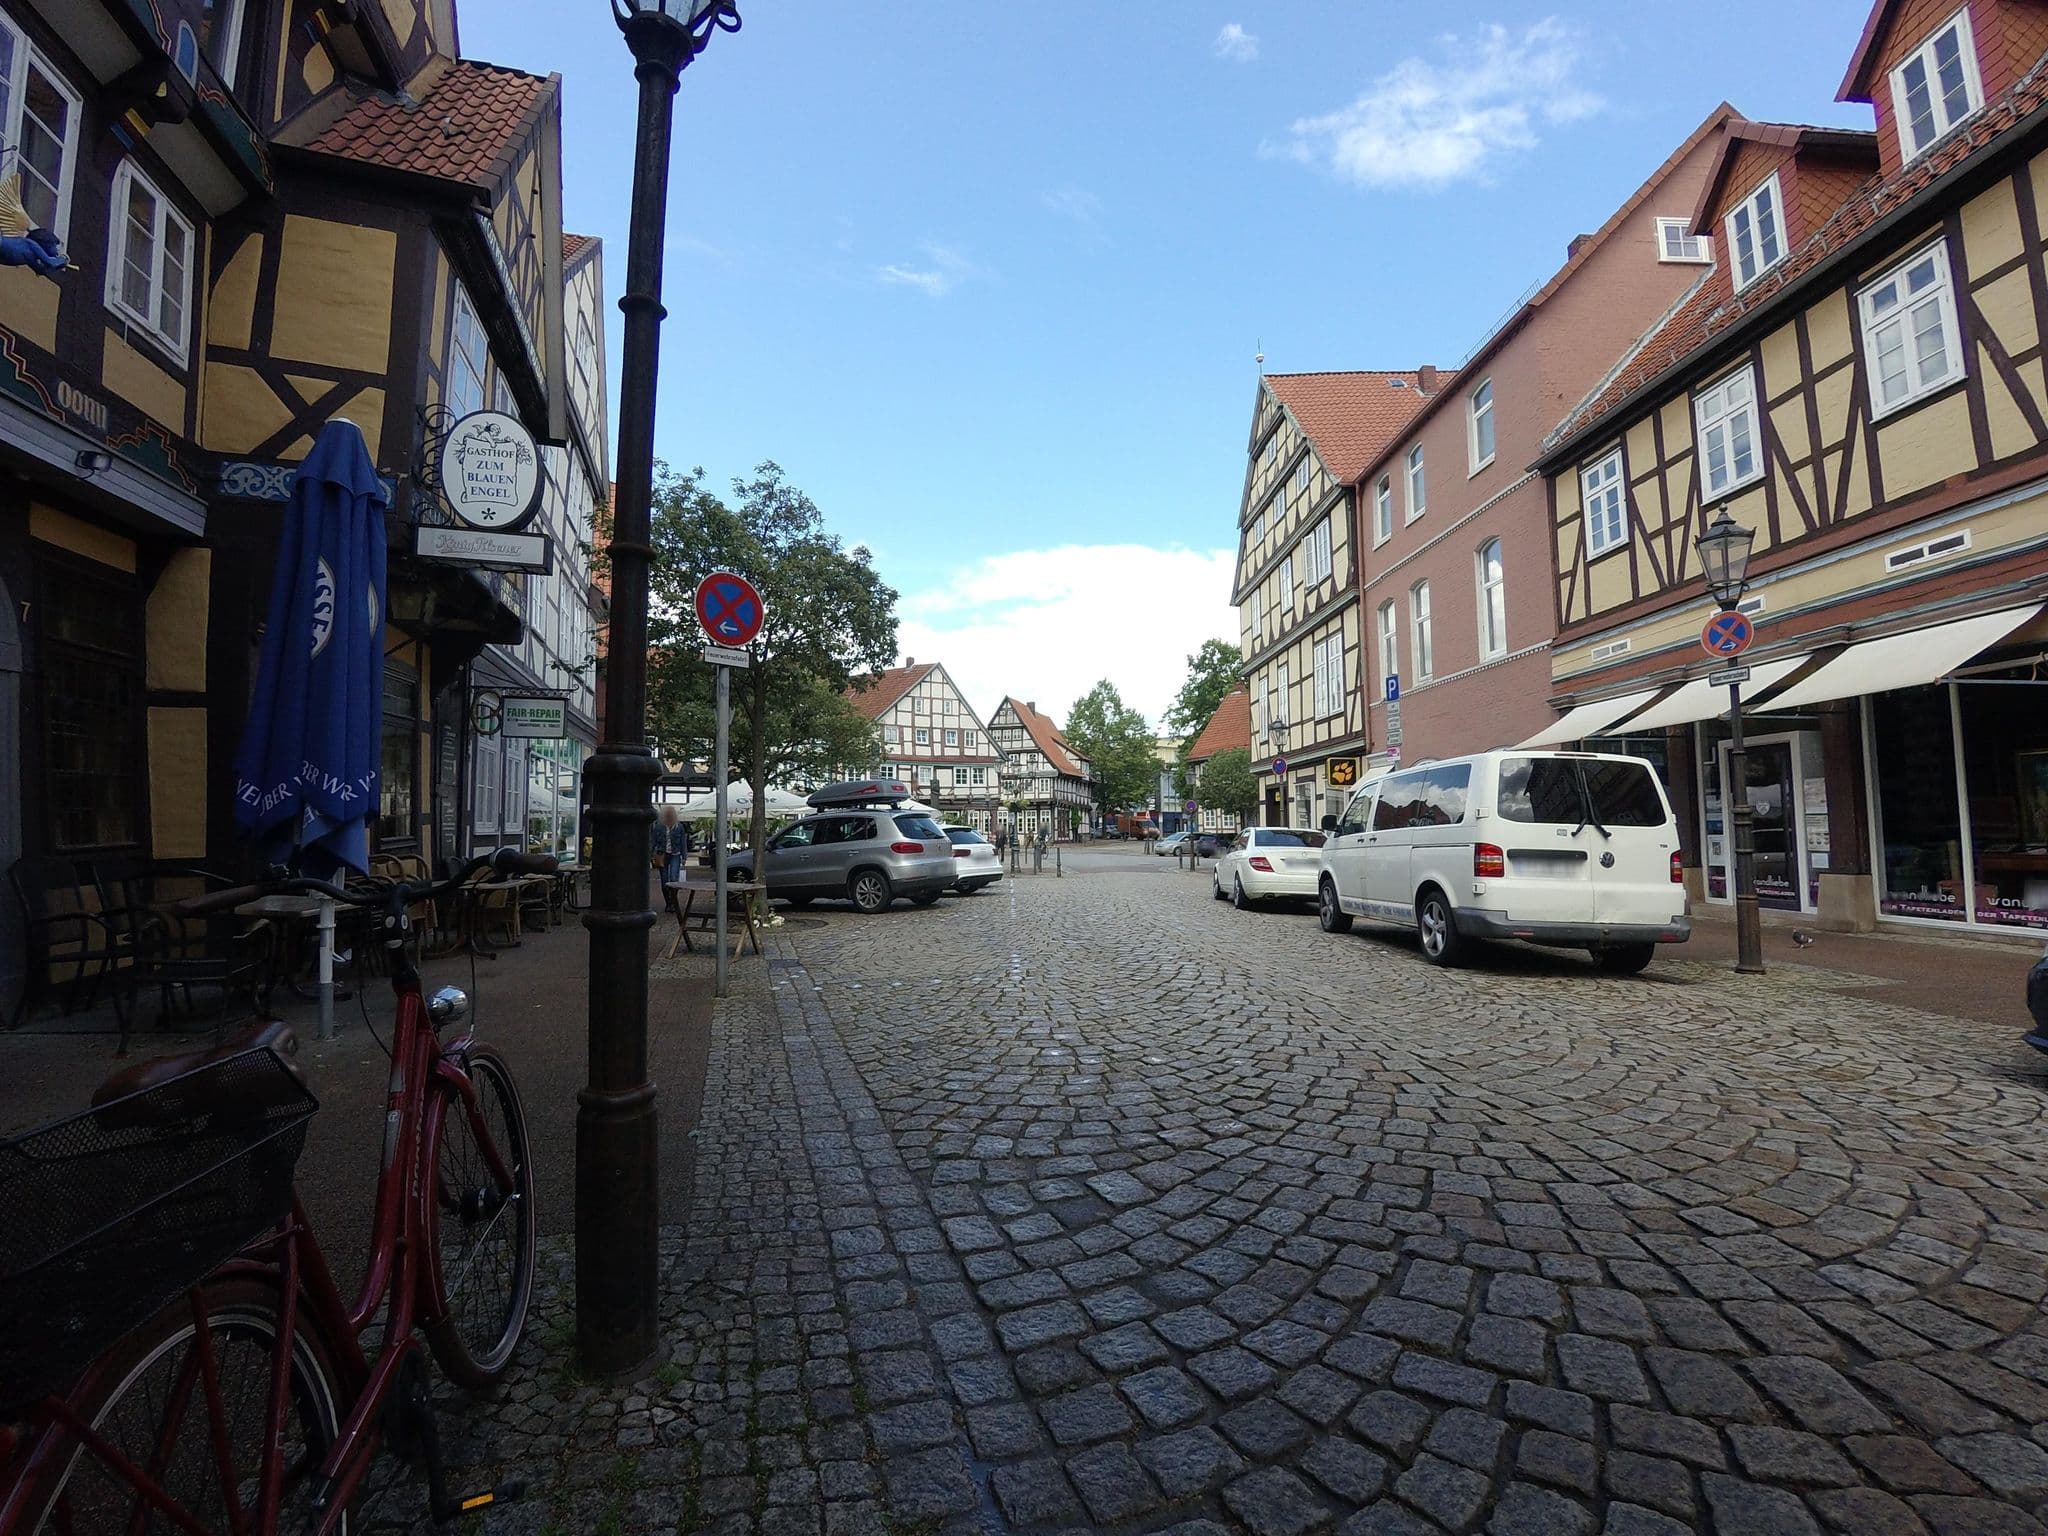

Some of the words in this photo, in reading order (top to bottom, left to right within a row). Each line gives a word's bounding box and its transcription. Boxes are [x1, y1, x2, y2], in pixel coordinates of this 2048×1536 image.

[466, 446, 515, 459] GASTHOF
[476, 460, 504, 471] ZUM
[467, 473, 515, 484] BLAUEN
[470, 486, 510, 498] ENGEL
[20, 601, 31, 623] 7
[1388, 679, 1397, 698] P
[507, 708, 561, 719] FAIR-REPAIR
